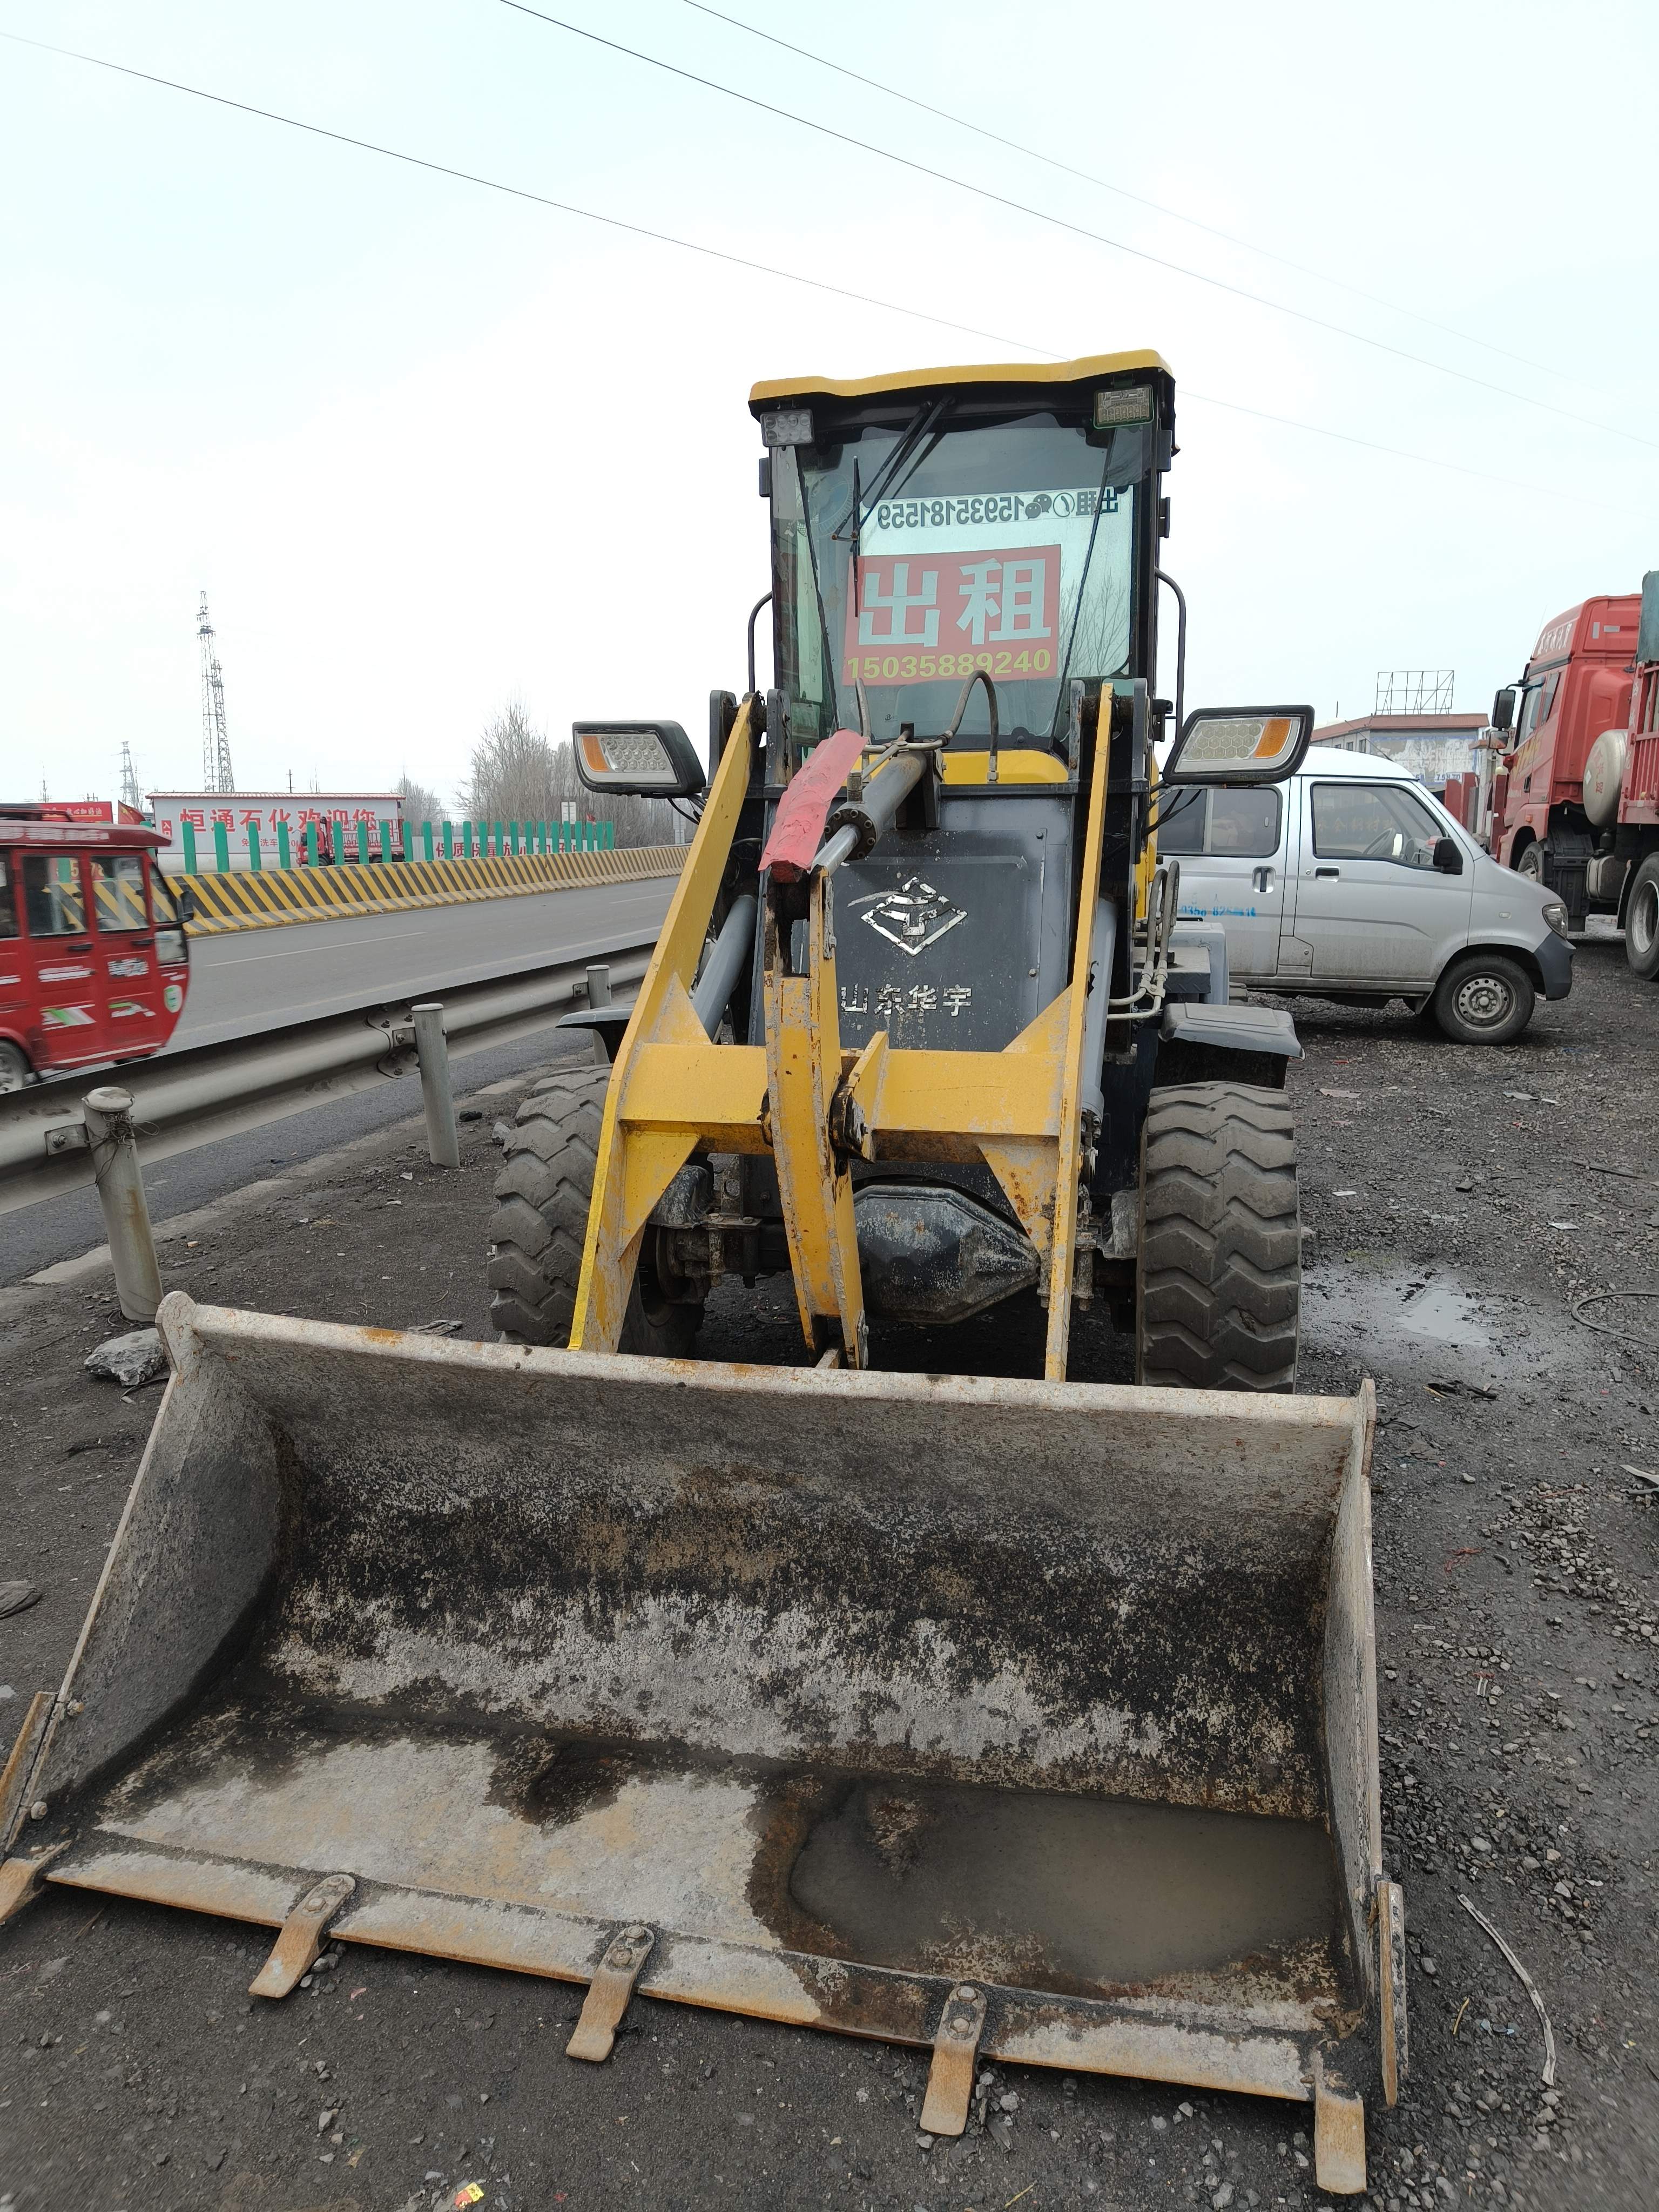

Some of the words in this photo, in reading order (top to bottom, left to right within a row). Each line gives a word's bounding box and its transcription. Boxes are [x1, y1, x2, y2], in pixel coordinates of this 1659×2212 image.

[858, 558, 1051, 647] 出租
[847, 649, 1050, 679] 15035889240
[179, 808, 377, 832] 恒通石化欢迎您
[841, 983, 972, 1018] 山东华宇
